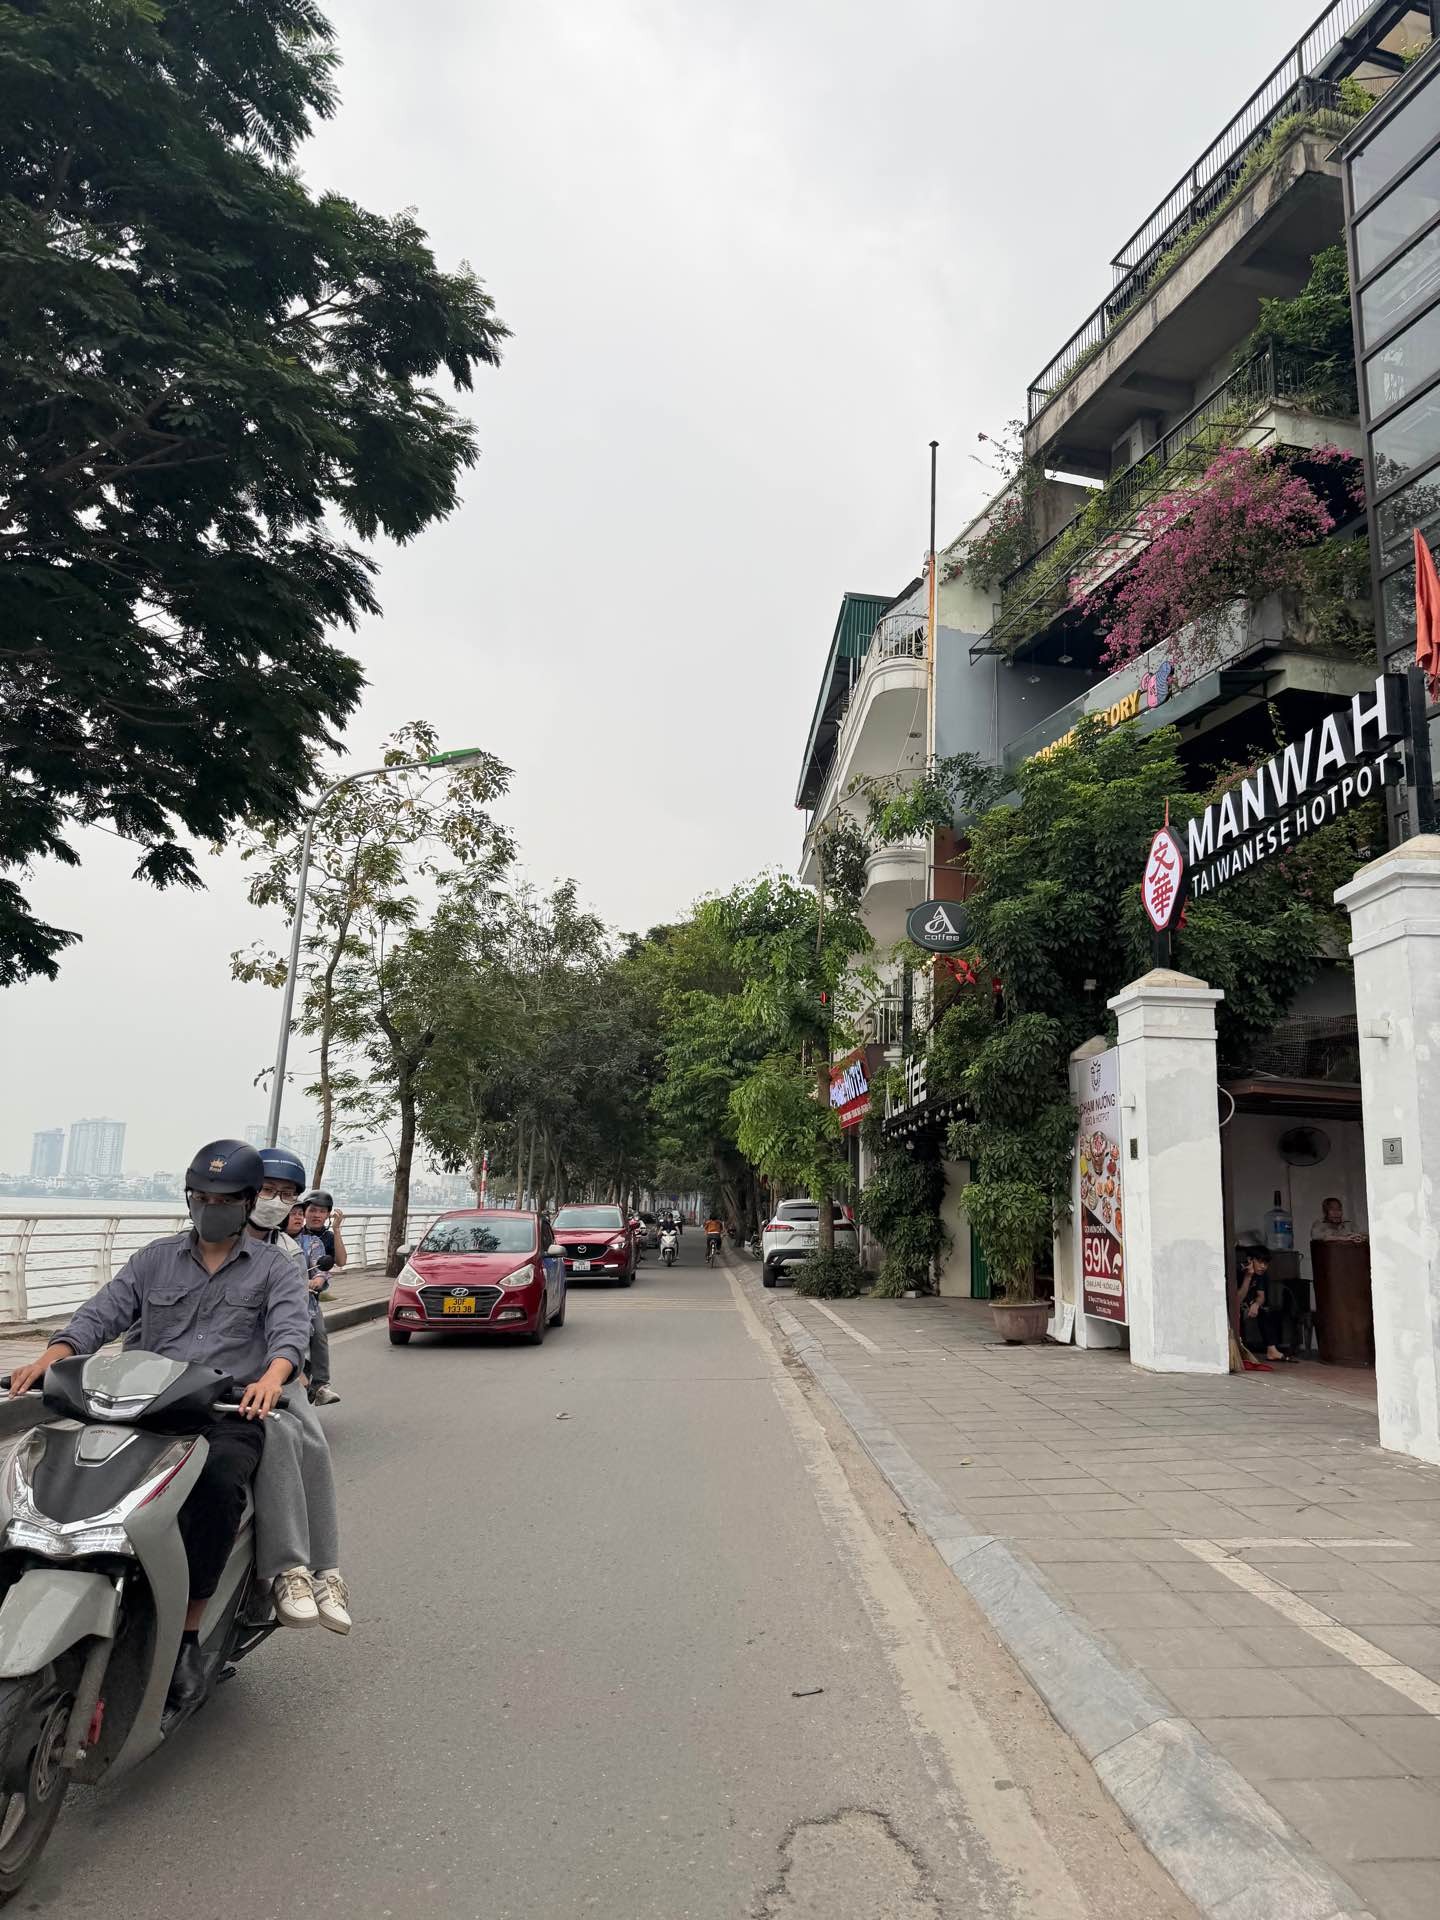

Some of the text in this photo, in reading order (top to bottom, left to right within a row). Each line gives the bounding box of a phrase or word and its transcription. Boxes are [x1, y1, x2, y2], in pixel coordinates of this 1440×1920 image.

[1188, 673, 1389, 866] MANWAH
[1192, 754, 1389, 898] TAIWANESE HOTPOT
[1148, 842, 1174, 919] 文華
[924, 934, 960, 942] coffee
[1084, 1237, 1111, 1274] 59K
